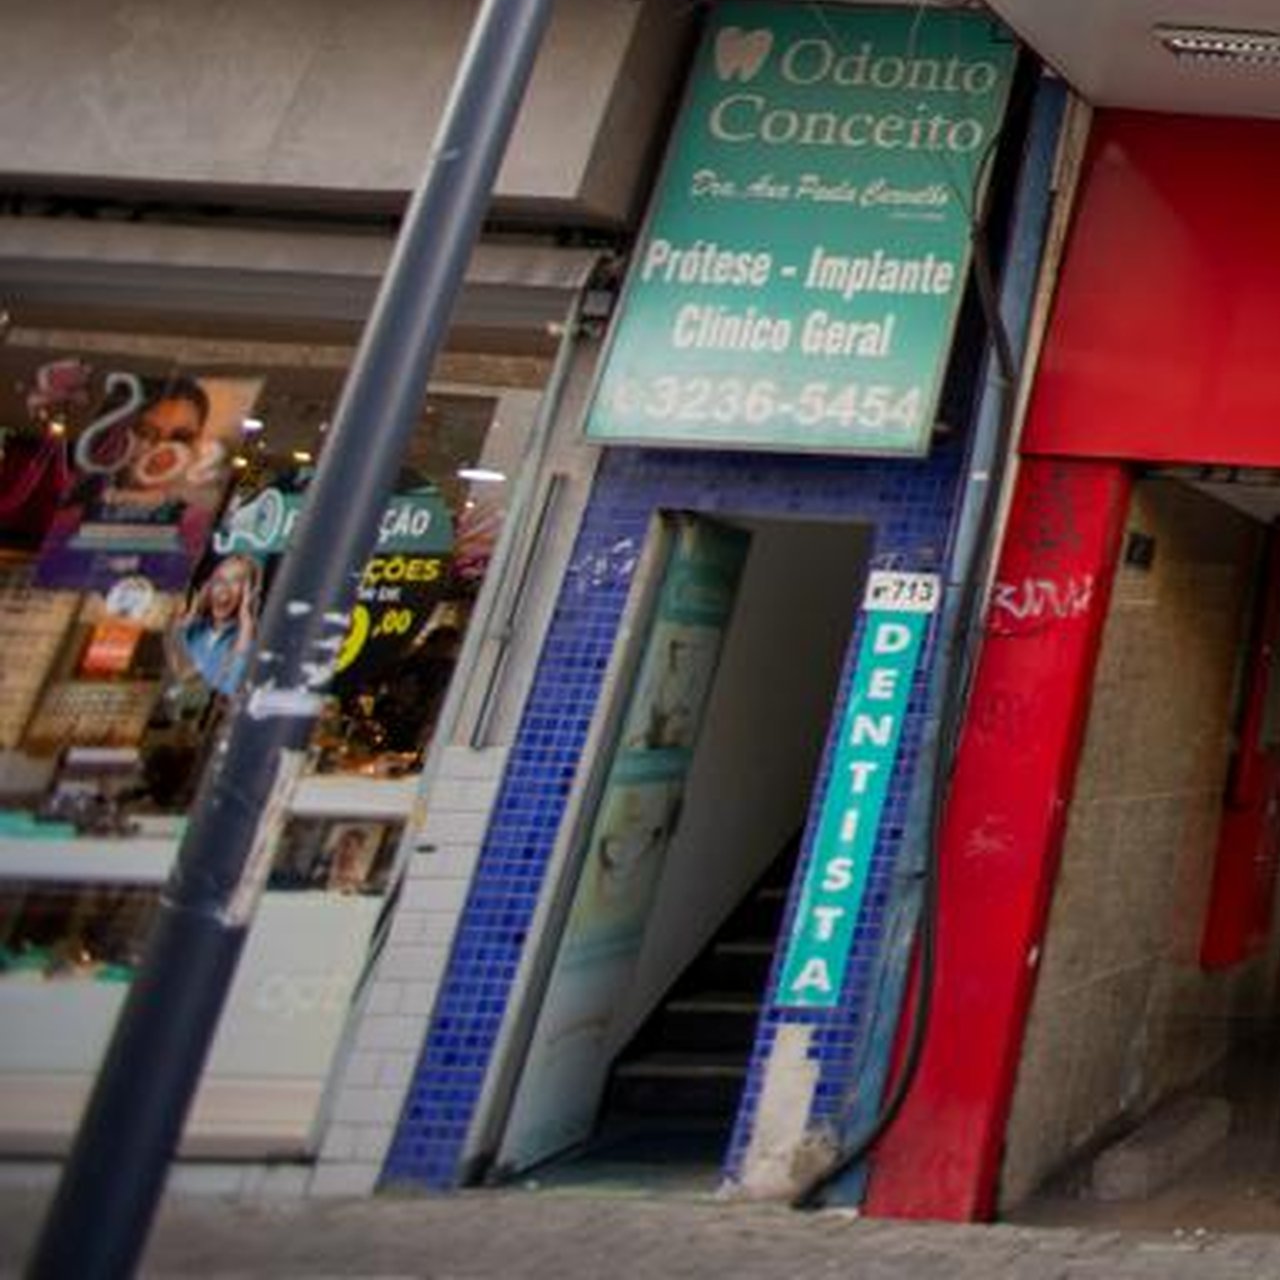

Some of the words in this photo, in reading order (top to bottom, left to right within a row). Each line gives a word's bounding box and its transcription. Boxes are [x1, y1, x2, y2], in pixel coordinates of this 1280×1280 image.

[780, 38, 998, 95] Odonto
[708, 93, 985, 153] Conceito
[641, 239, 772, 286] Prótese
[804, 246, 955, 300] Implante
[800, 310, 895, 358] Geral
[792, 623, 912, 993] DENTISTA
